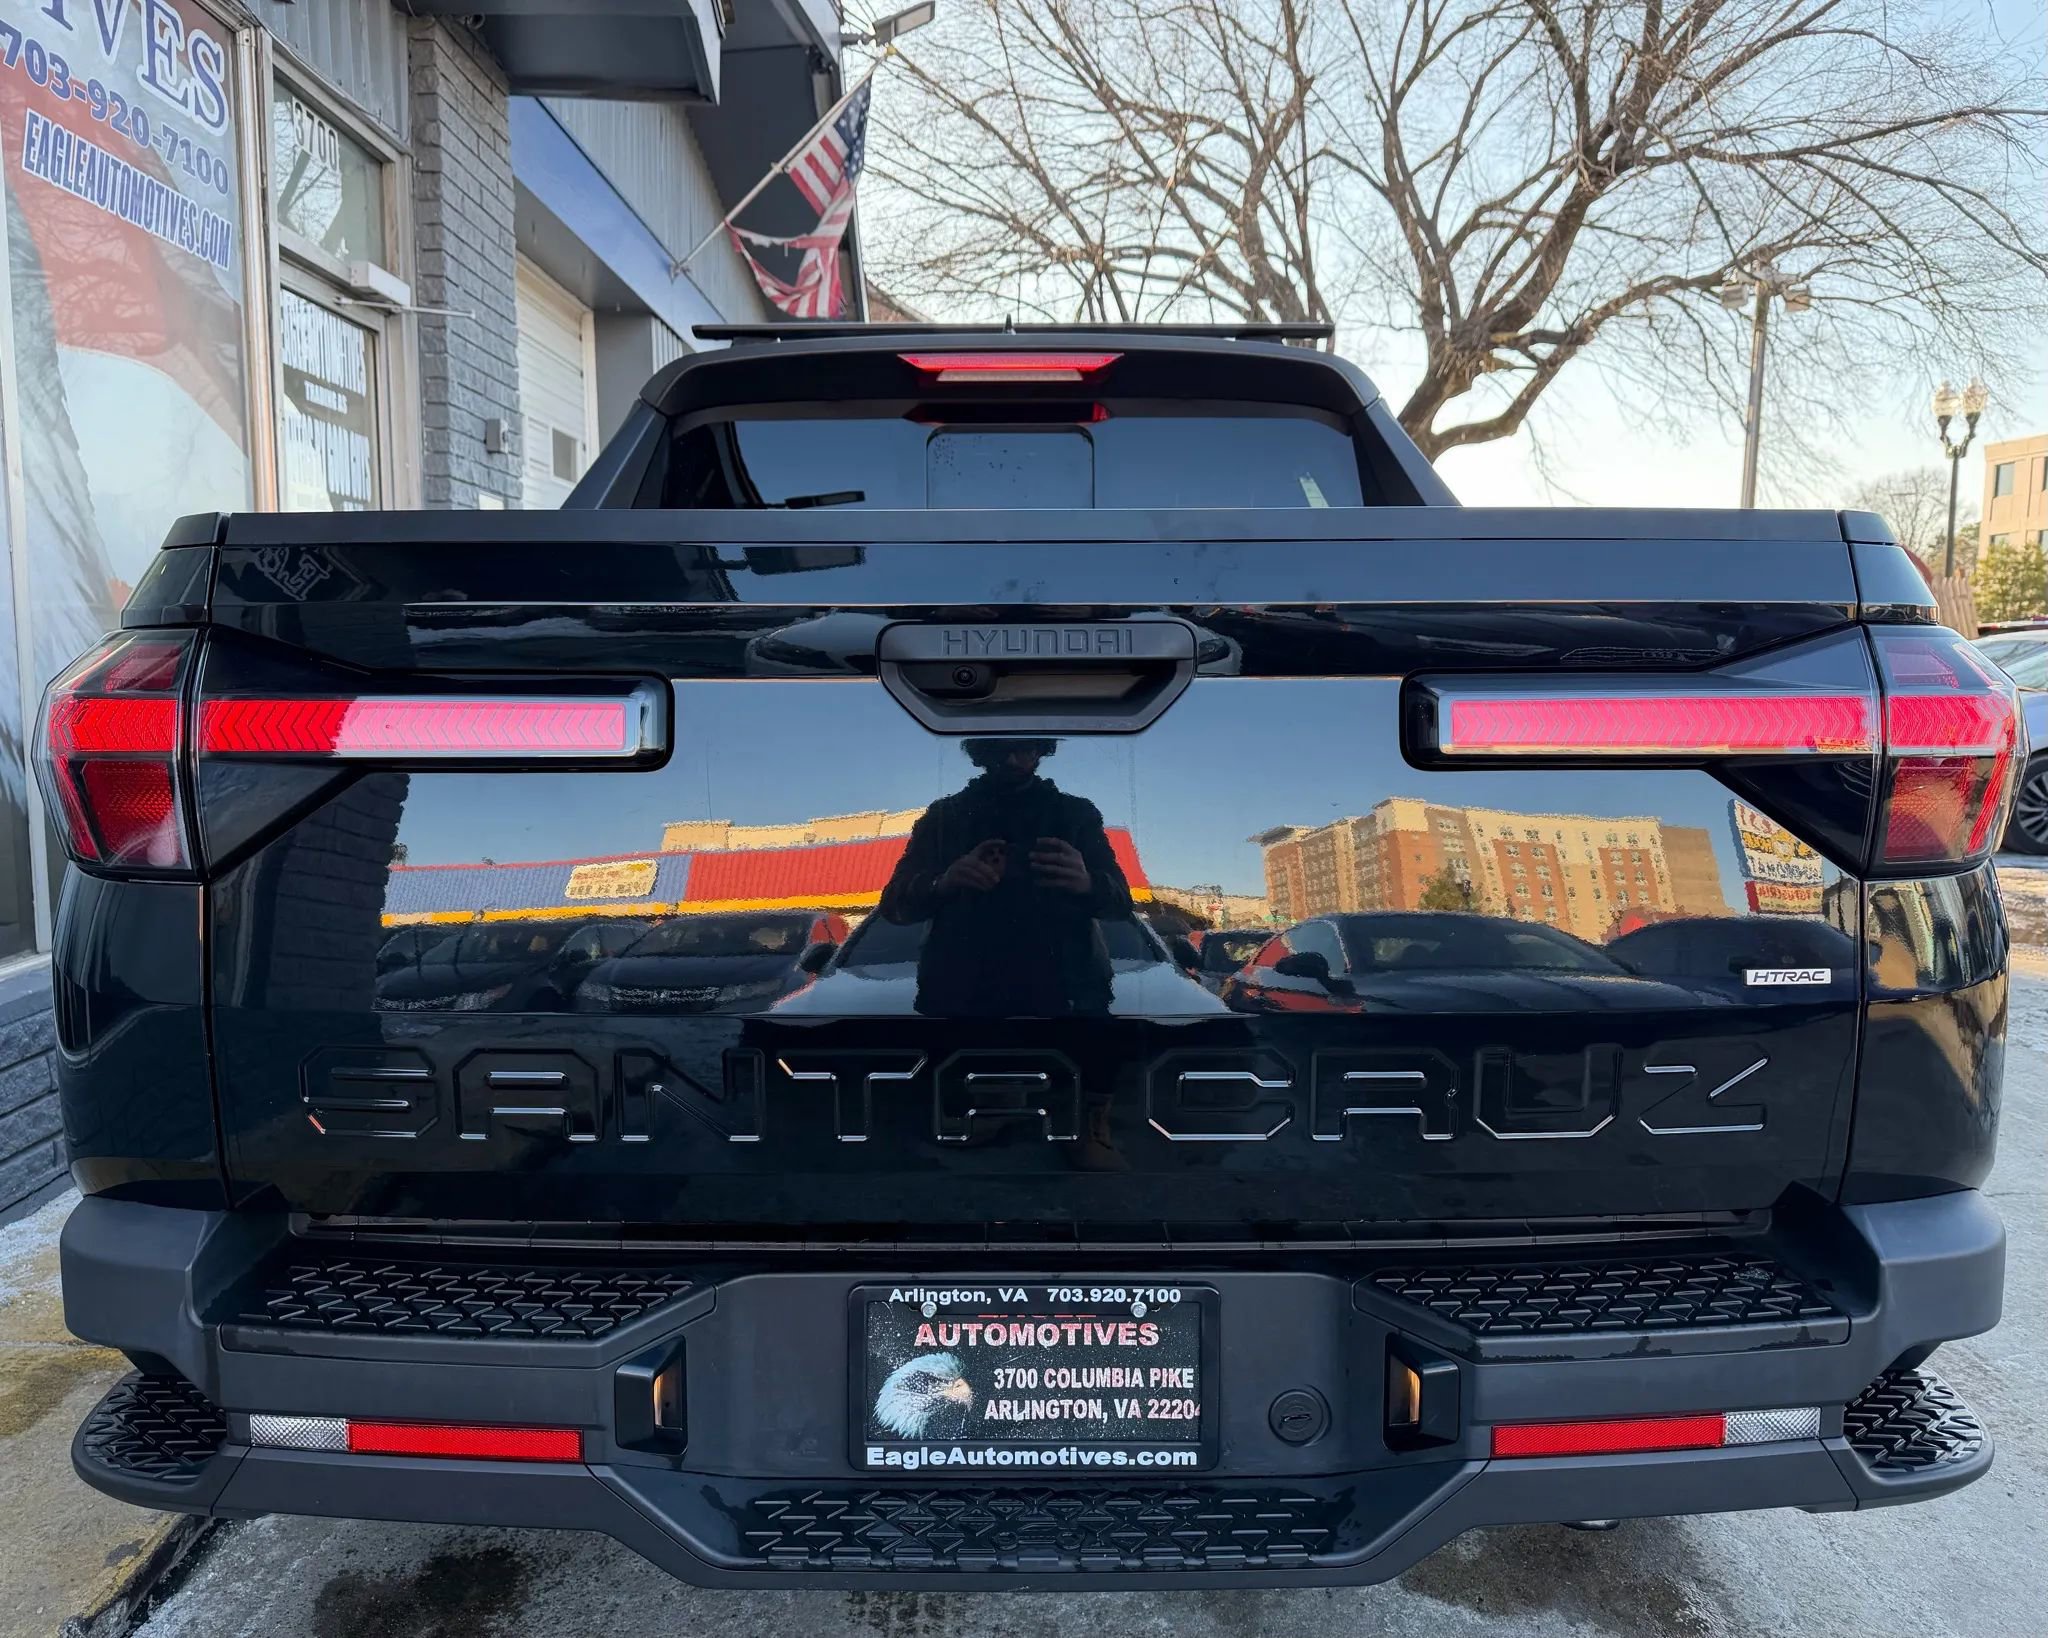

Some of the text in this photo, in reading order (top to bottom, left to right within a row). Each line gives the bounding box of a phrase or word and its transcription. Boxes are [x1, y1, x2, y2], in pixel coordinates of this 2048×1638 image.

[0, 19, 229, 196] 703-920-7100
[294, 99, 339, 172] 3700
[22, 107, 232, 271] EAGLEAUTOMOTIVES.COM
[942, 628, 1134, 656] HYUNDAI
[1753, 971, 1826, 983] HTRAC
[300, 1043, 1770, 1142] SANTA CRUZ
[889, 1288, 1182, 1305] Arlington, VA 703.920.7100
[914, 1322, 1160, 1347] AUTOMOTIVES
[994, 1367, 1195, 1389] 3700 COLUMBIA PIKE
[984, 1398, 1108, 1424] ARLINGTON,
[1113, 1398, 1142, 1419] VA
[866, 1446, 1198, 1470] EagleAutomotives.com
